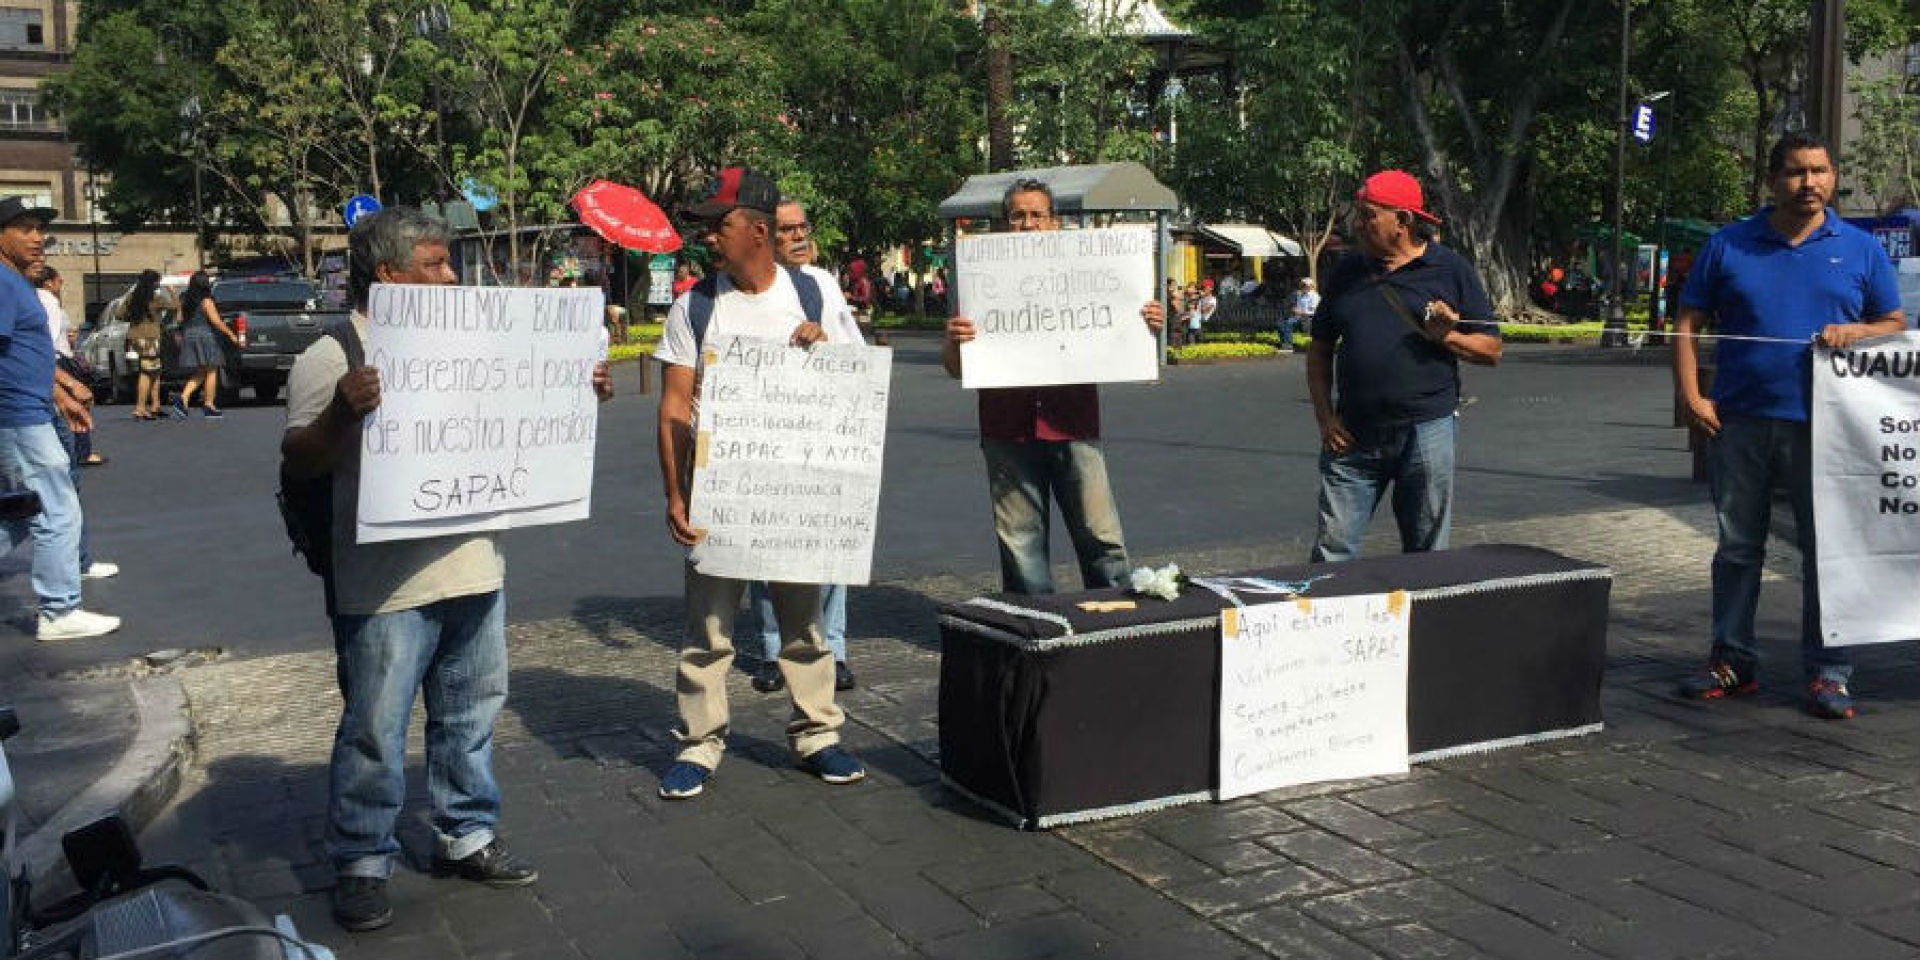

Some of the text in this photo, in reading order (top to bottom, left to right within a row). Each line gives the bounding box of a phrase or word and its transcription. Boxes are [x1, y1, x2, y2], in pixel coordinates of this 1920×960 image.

[963, 265, 1120, 306] Te exigimos
[983, 301, 1112, 334] audiencia
[371, 348, 505, 393] Queremos
[515, 345, 534, 390] el
[1830, 350, 1920, 378] CUAU
[711, 374, 741, 402] los
[365, 406, 400, 456] de
[415, 402, 505, 455] nuestra
[714, 440, 785, 460] SAPAC
[1880, 444, 1917, 462] No
[413, 467, 529, 512] SAPAC
[703, 468, 730, 493] de
[711, 506, 736, 525] NO
[1879, 497, 1920, 515] No
[1342, 633, 1401, 664] SAPAC
